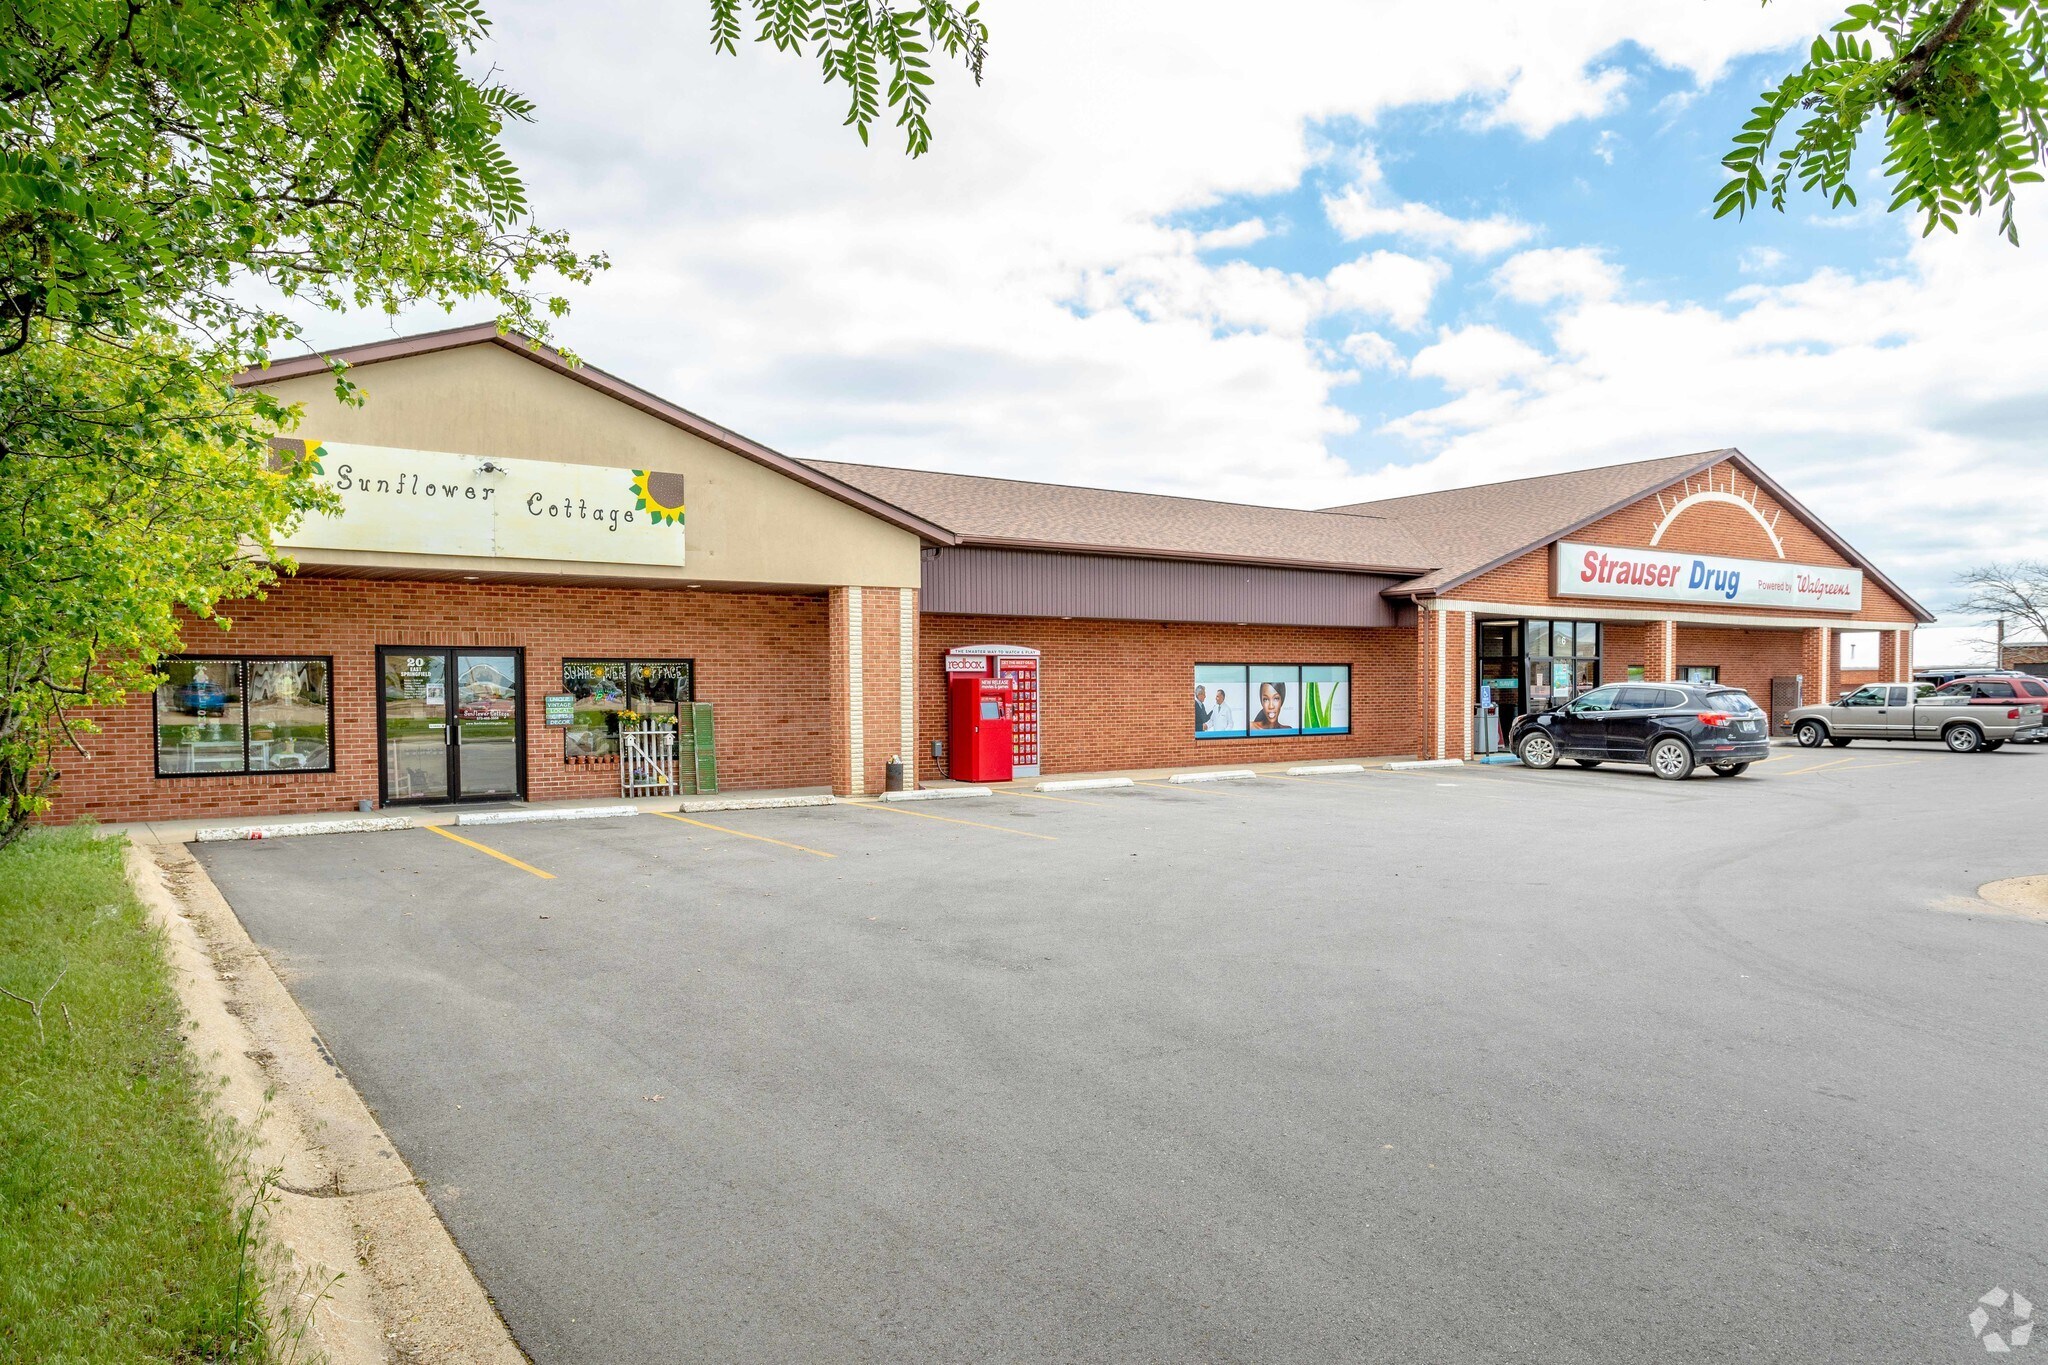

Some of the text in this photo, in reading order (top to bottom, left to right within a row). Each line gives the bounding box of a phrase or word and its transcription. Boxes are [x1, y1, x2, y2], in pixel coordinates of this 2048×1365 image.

[336, 463, 635, 532] Sunflower Cottage
[1580, 550, 1851, 600] Strauser Drug Powered by Walgreens
[407, 657, 425, 667] 20
